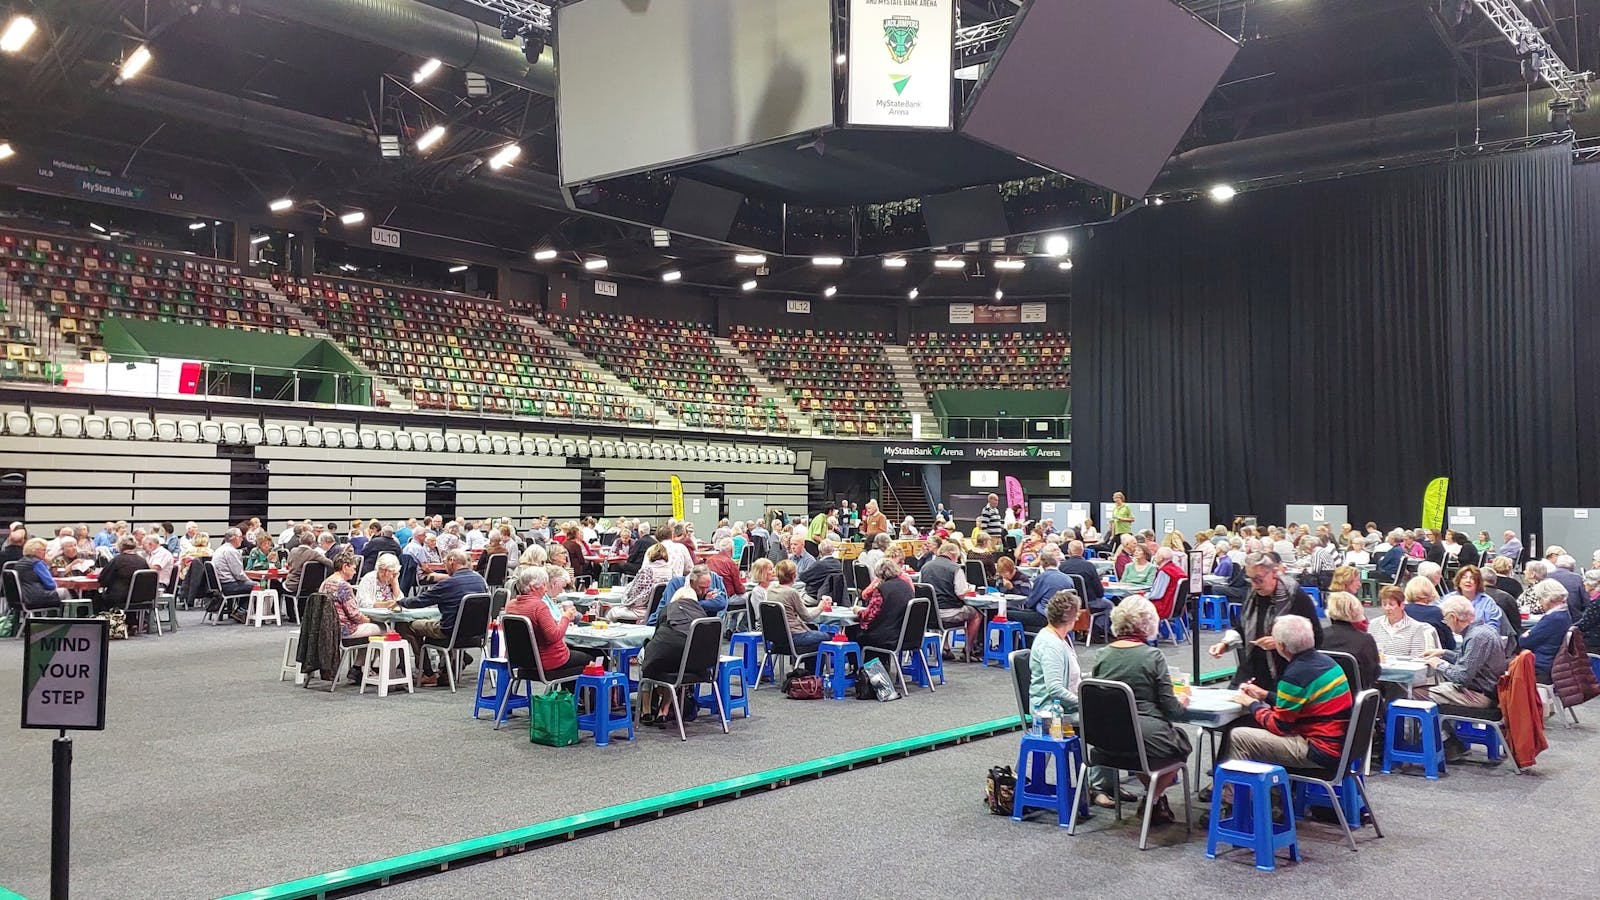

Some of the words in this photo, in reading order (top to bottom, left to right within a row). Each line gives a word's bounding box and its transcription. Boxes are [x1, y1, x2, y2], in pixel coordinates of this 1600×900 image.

[876, 99, 921, 108] MyStateBank
[82, 181, 134, 197] MyStateBank
[373, 231, 398, 244] UL10
[598, 282, 615, 294] UL11
[789, 301, 808, 311] UL12
[884, 446, 932, 456] MyStateBank
[941, 447, 964, 456] Arena
[975, 447, 1027, 458] MyStateBank
[1037, 448, 1061, 457] Arena
[40, 637, 91, 652] MIND
[38, 663, 90, 679] YOUR
[41, 690, 85, 705] STEP
